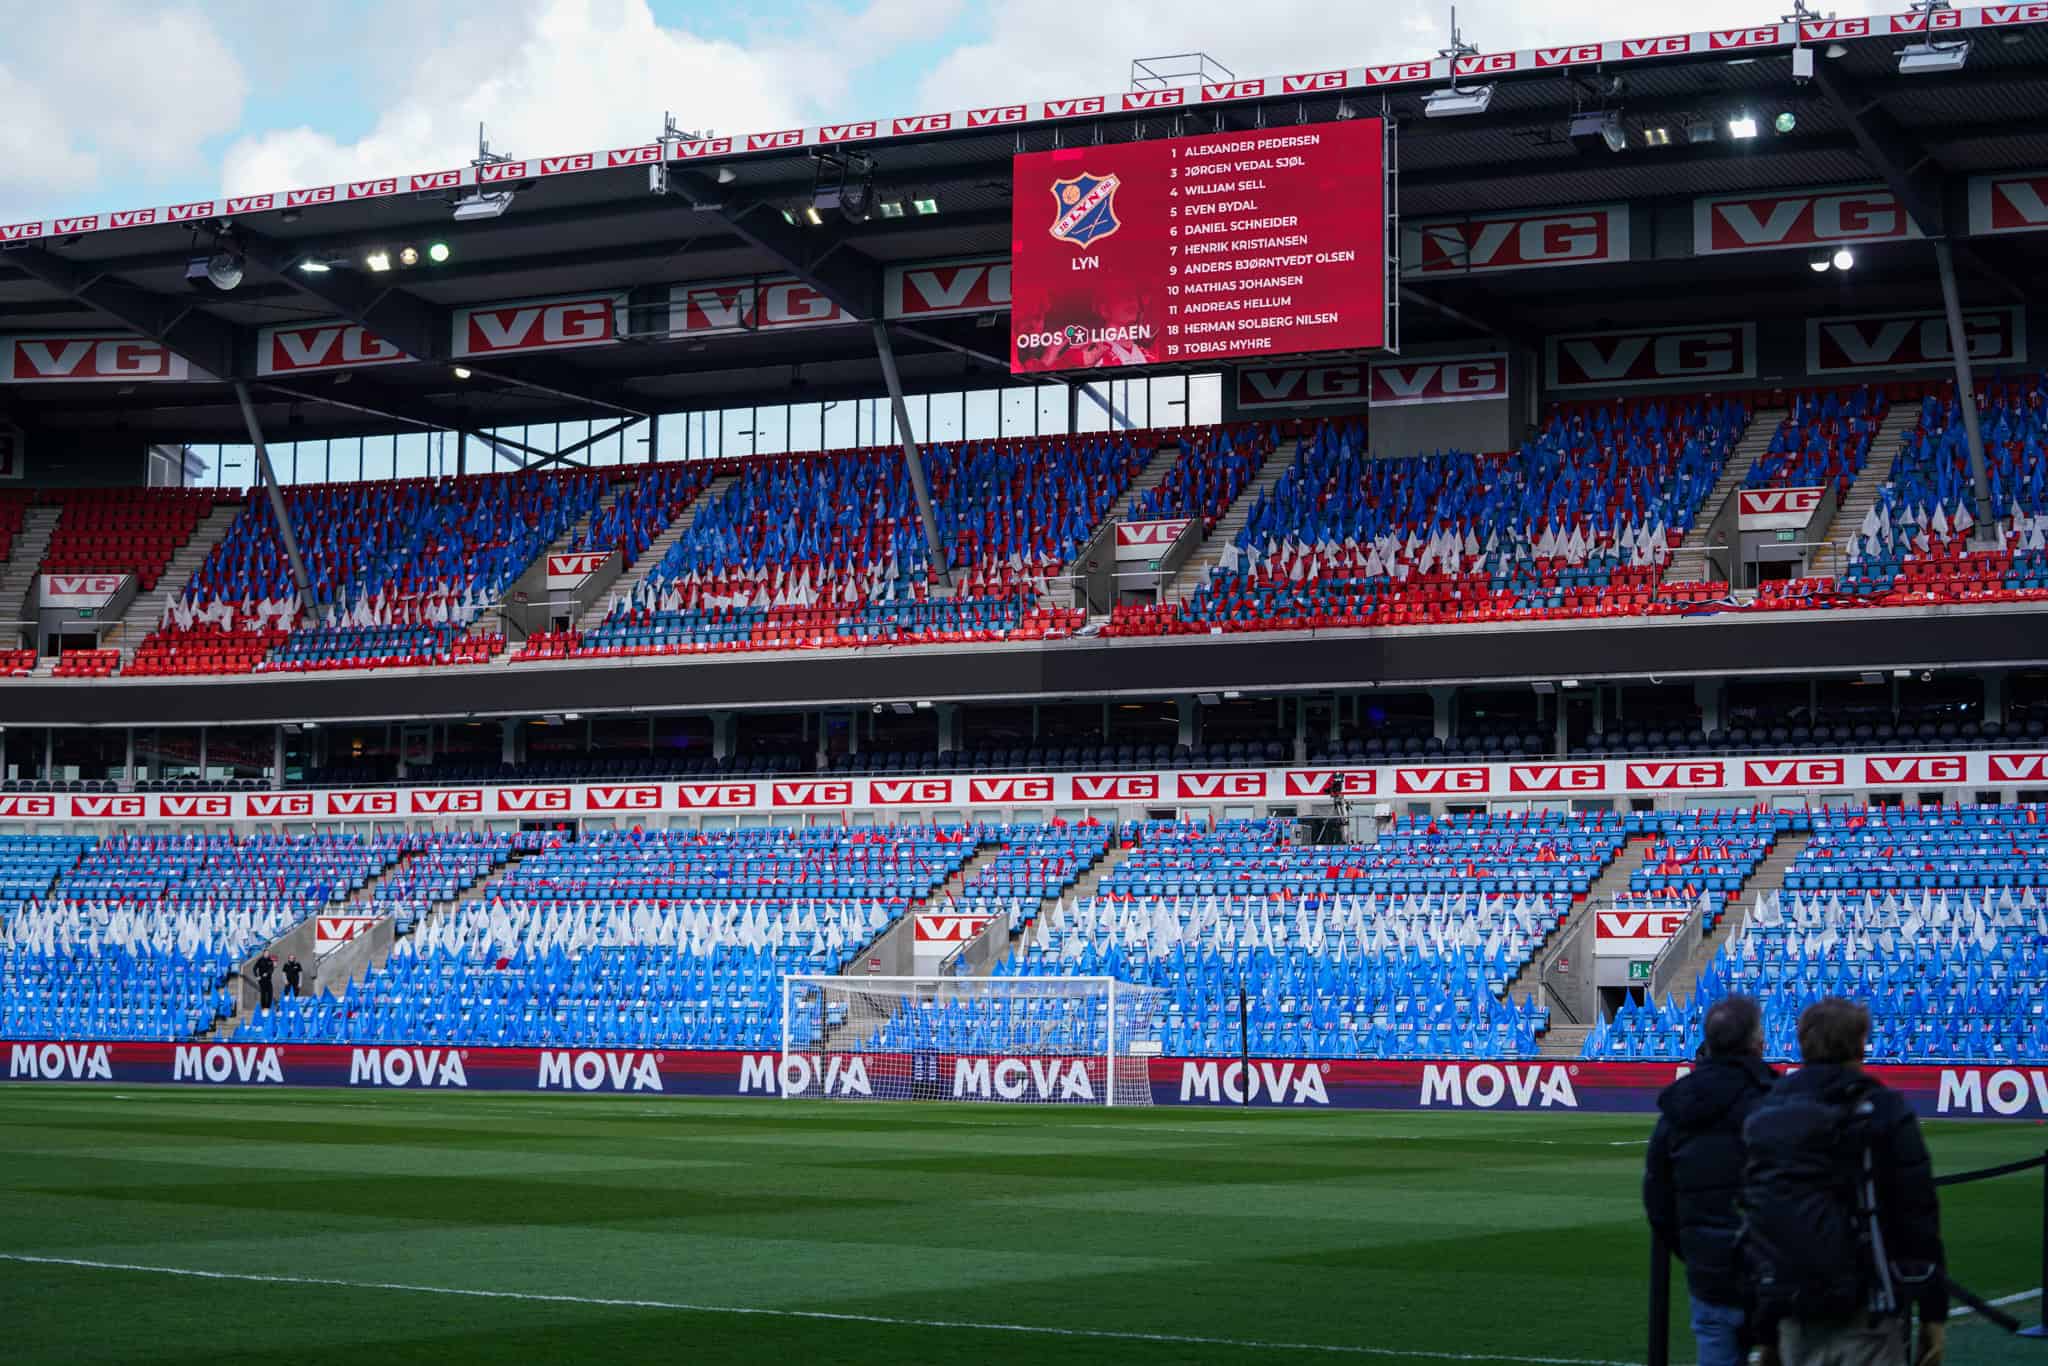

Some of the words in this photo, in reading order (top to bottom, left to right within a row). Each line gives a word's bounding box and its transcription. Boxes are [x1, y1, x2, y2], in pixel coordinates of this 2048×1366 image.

[1893, 12, 1956, 30] VG
[1984, 4, 2048, 22] VG
[1713, 29, 1774, 47] VG
[1802, 20, 1865, 39] VG
[1624, 37, 1685, 55] VG
[1456, 56, 1512, 73] VG
[1538, 47, 1598, 64] VG
[1285, 73, 1343, 90] VG
[1369, 65, 1426, 82] VG
[1124, 91, 1179, 108] VG
[1204, 82, 1260, 99] VG
[971, 107, 1023, 126] VG
[1047, 99, 1101, 116] VG
[823, 124, 873, 141] VG
[896, 115, 948, 133] VG
[680, 139, 729, 156] VG
[752, 131, 800, 148] VG
[1171, 149, 1176, 158] 1
[1185, 142, 1254, 157] ALEXANDER
[1258, 135, 1320, 150] PEDERSEN
[544, 156, 591, 172] VG
[612, 148, 661, 164] VG
[480, 164, 525, 180] VG
[1170, 168, 1178, 178] 3
[1185, 162, 1232, 177] JØRGEN
[1234, 158, 1273, 172] VEDAL
[1276, 156, 1305, 168] SJØL
[351, 180, 395, 195] VG
[414, 173, 459, 188] VG
[1170, 188, 1178, 197] 4
[1185, 182, 1235, 196] WILLIAM
[1238, 180, 1266, 191] SELL
[228, 196, 272, 211] VG
[289, 188, 333, 204] VG
[170, 204, 212, 218] VG
[1170, 207, 1177, 217] 5
[1185, 204, 1216, 216] EVEN
[1218, 200, 1257, 213] BYDAL
[55, 218, 96, 232] VG
[113, 211, 153, 226] VG
[1170, 226, 1178, 237] 6
[1185, 222, 1228, 235] DANIEL
[1230, 216, 1297, 231] SCHNEIDER
[1717, 193, 1895, 244] VG
[1, 224, 41, 239] VG
[1170, 246, 1177, 256] 7
[1185, 242, 1228, 255] HENRIK
[1231, 235, 1308, 251] KRISTIANSEN
[1426, 216, 1598, 266] VG
[1072, 256, 1099, 270] LYN
[1169, 266, 1178, 276] 9
[1184, 261, 1233, 275] ANDERS
[1235, 254, 1313, 271] BJØRNTVEDT
[1315, 250, 1354, 263] OLSEN
[1168, 286, 1179, 296] 10
[1184, 281, 1237, 294] MATHIAS
[1239, 275, 1303, 290] JOHANSEN
[691, 283, 832, 327] VG
[1169, 305, 1177, 315] 11
[1184, 300, 1241, 314] ANDREAS
[1243, 296, 1291, 309] HELLUM
[472, 304, 605, 347] VG
[1167, 325, 1179, 335] 18
[1184, 321, 1236, 334] HERMAN
[1238, 316, 1293, 330] SOLBERG
[1296, 312, 1338, 325] NILSEN
[1017, 332, 1063, 348] OBOS
[1092, 325, 1151, 342] LIGAEN
[1822, 317, 2002, 364] VG
[1168, 345, 1179, 355] 19
[1184, 340, 1227, 354] TOBIAS
[1230, 338, 1271, 350] MYHRE
[19, 340, 162, 375] VG
[1563, 333, 1732, 380] VG
[1247, 367, 1360, 399] VG
[1377, 362, 1497, 396] VG
[1744, 491, 1820, 511] VG
[53, 578, 115, 592] VG
[1631, 765, 1716, 786] VG
[1750, 762, 1837, 783] VG
[1871, 759, 1959, 780] VG
[1994, 757, 2048, 777] V
[1182, 775, 1260, 795] VG
[1290, 773, 1373, 793] VG
[1400, 770, 1483, 791] VG
[1515, 768, 1598, 788] VG
[682, 786, 750, 805] VG
[776, 784, 846, 803] VG
[874, 782, 946, 801] VG
[973, 780, 1048, 800] VG
[1077, 778, 1152, 797] VG
[76, 798, 140, 815] VG
[163, 798, 226, 814] VG
[251, 796, 308, 814] VG
[331, 794, 392, 812] VG
[415, 792, 477, 810] VG
[502, 790, 565, 808] VG
[590, 788, 656, 807] VG
